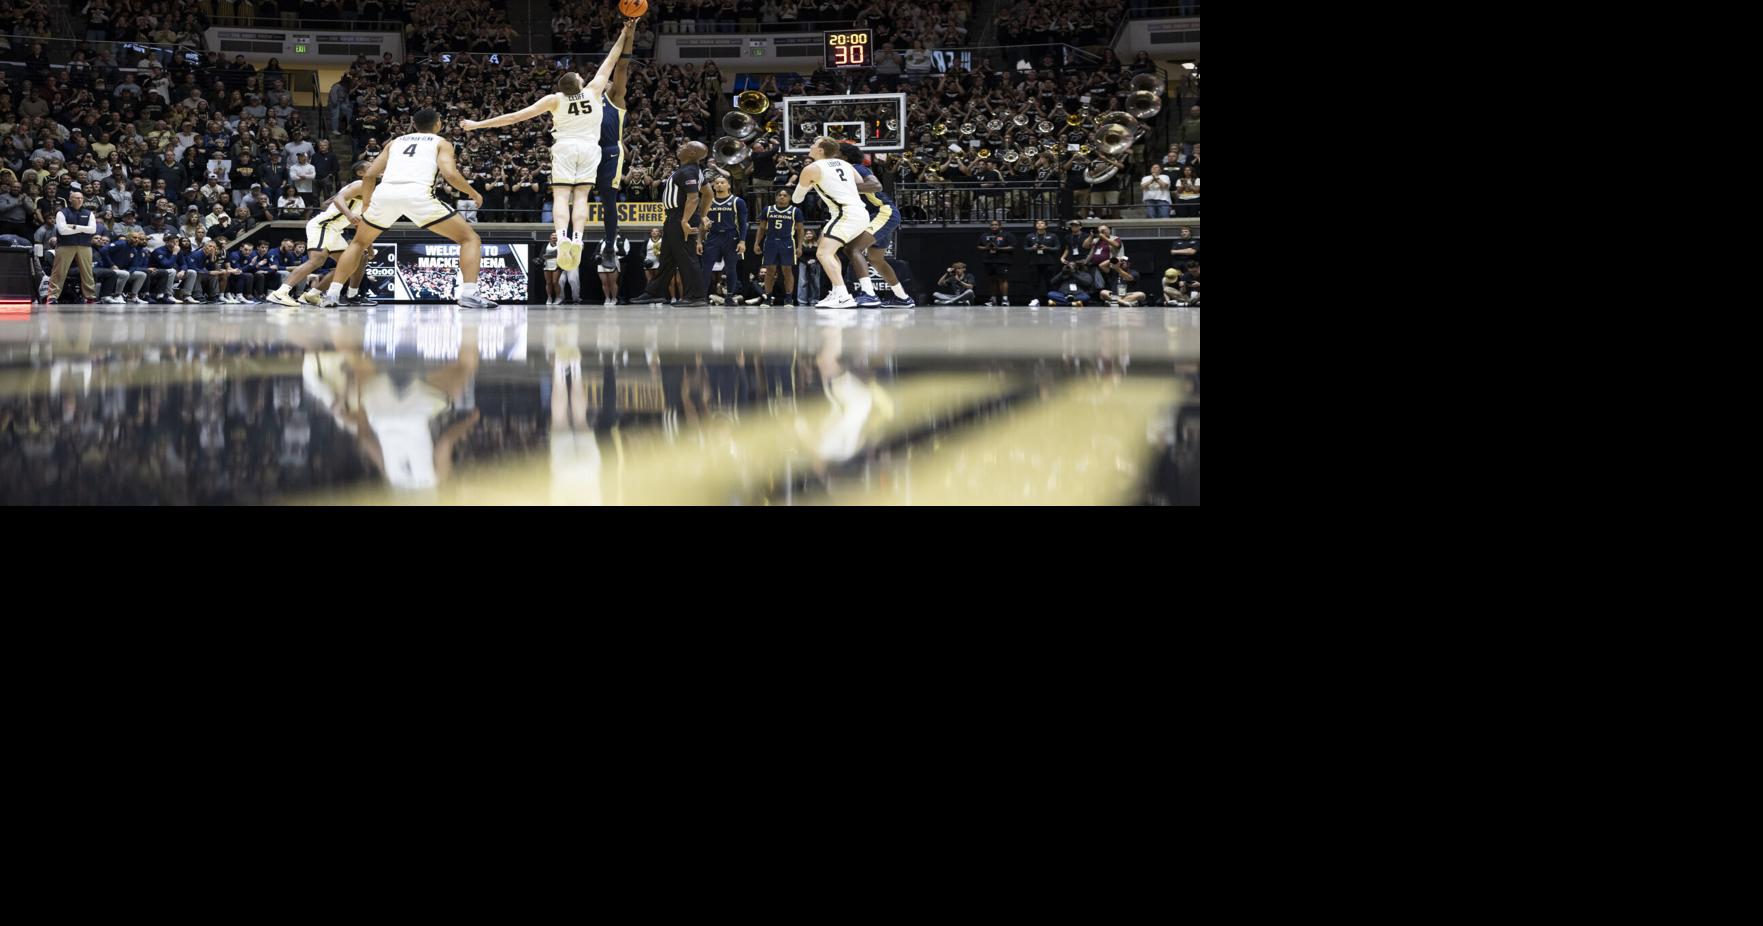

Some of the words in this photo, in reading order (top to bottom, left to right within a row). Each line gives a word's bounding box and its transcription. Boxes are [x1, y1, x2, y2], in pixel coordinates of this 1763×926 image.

[829, 34, 868, 45] 20:00
[835, 46, 864, 65] 30
[568, 100, 593, 116] 45
[403, 143, 418, 158] 4
[835, 168, 848, 182] 2
[638, 204, 663, 213] LIVES
[638, 214, 663, 222] HERE
[717, 212, 721, 223] 1
[774, 219, 783, 230] 5
[483, 246, 498, 256] TO
[387, 253, 395, 263] 0
[418, 257, 461, 268] MACKE
[387, 283, 395, 292] 0
